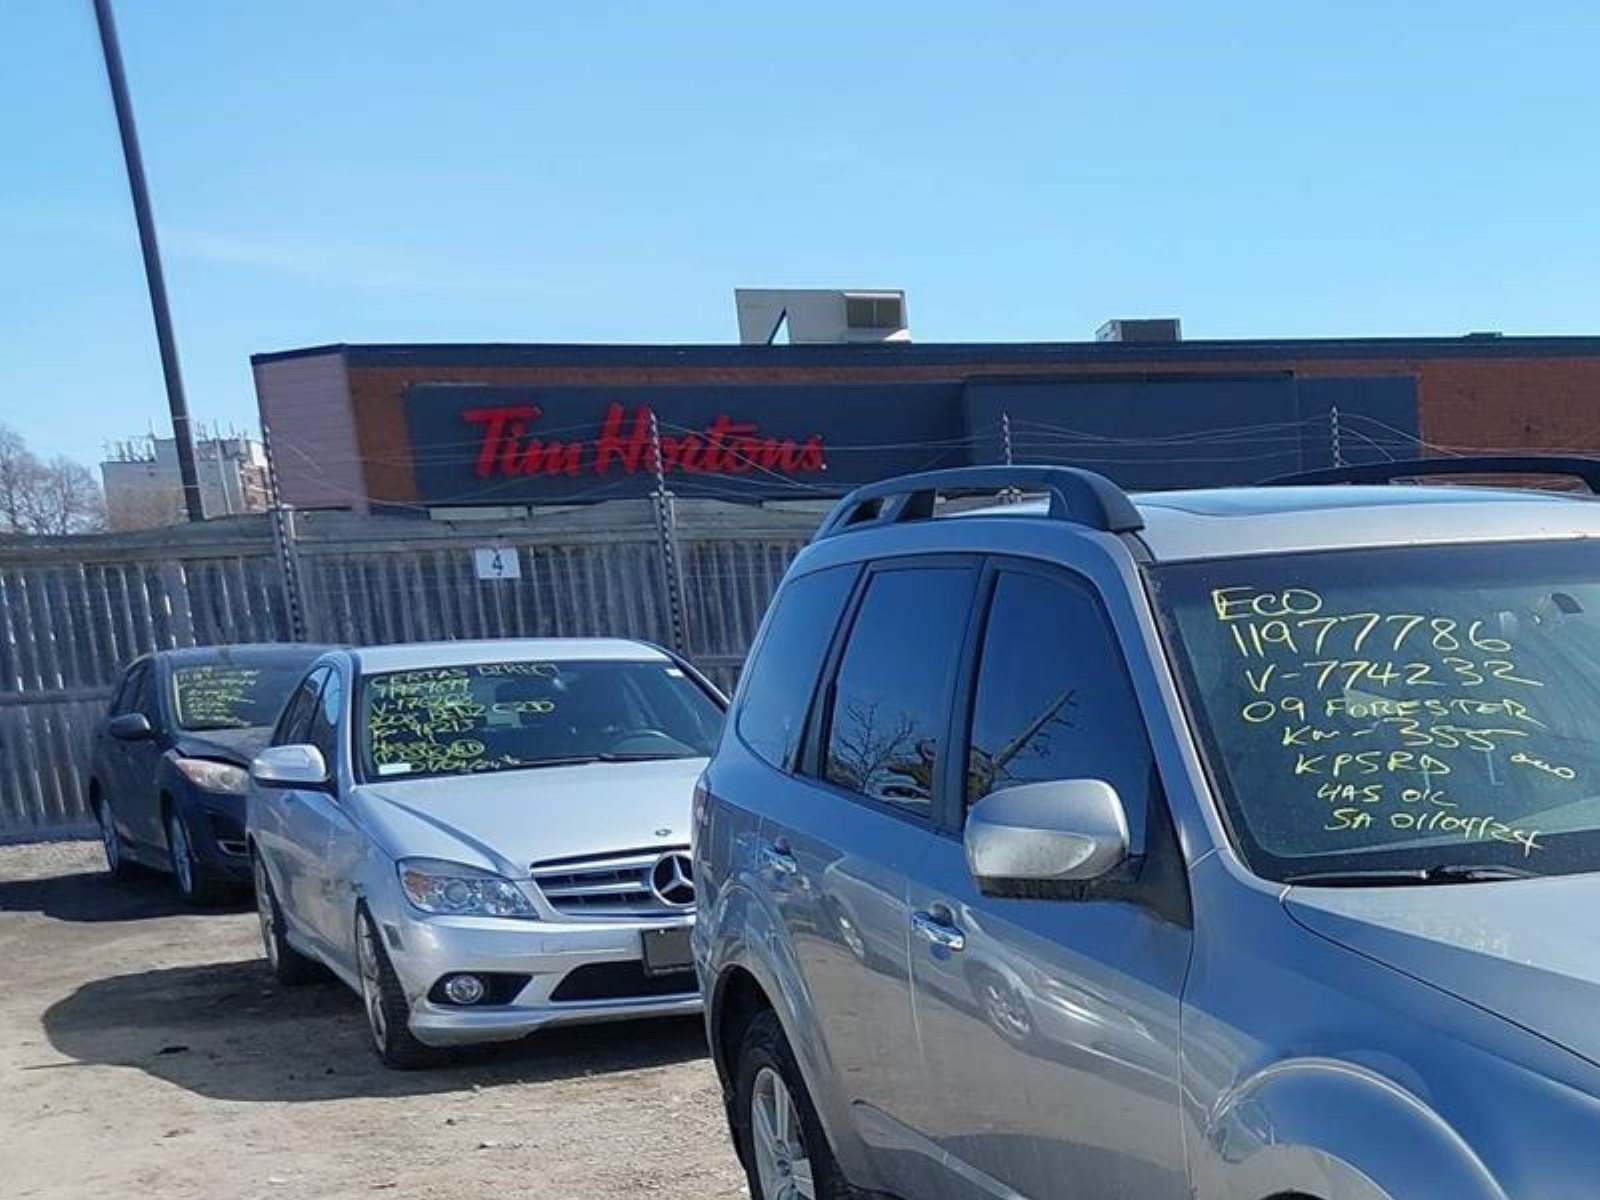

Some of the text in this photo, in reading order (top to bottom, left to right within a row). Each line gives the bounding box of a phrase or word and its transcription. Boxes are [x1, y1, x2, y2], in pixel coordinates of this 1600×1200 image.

[460, 401, 826, 478] Tim Hortons
[1211, 587, 1323, 620] ECO
[1231, 613, 1512, 657] 11977786
[1242, 697, 1550, 728] 09 FORESTER
[1324, 808, 1371, 831] SA
